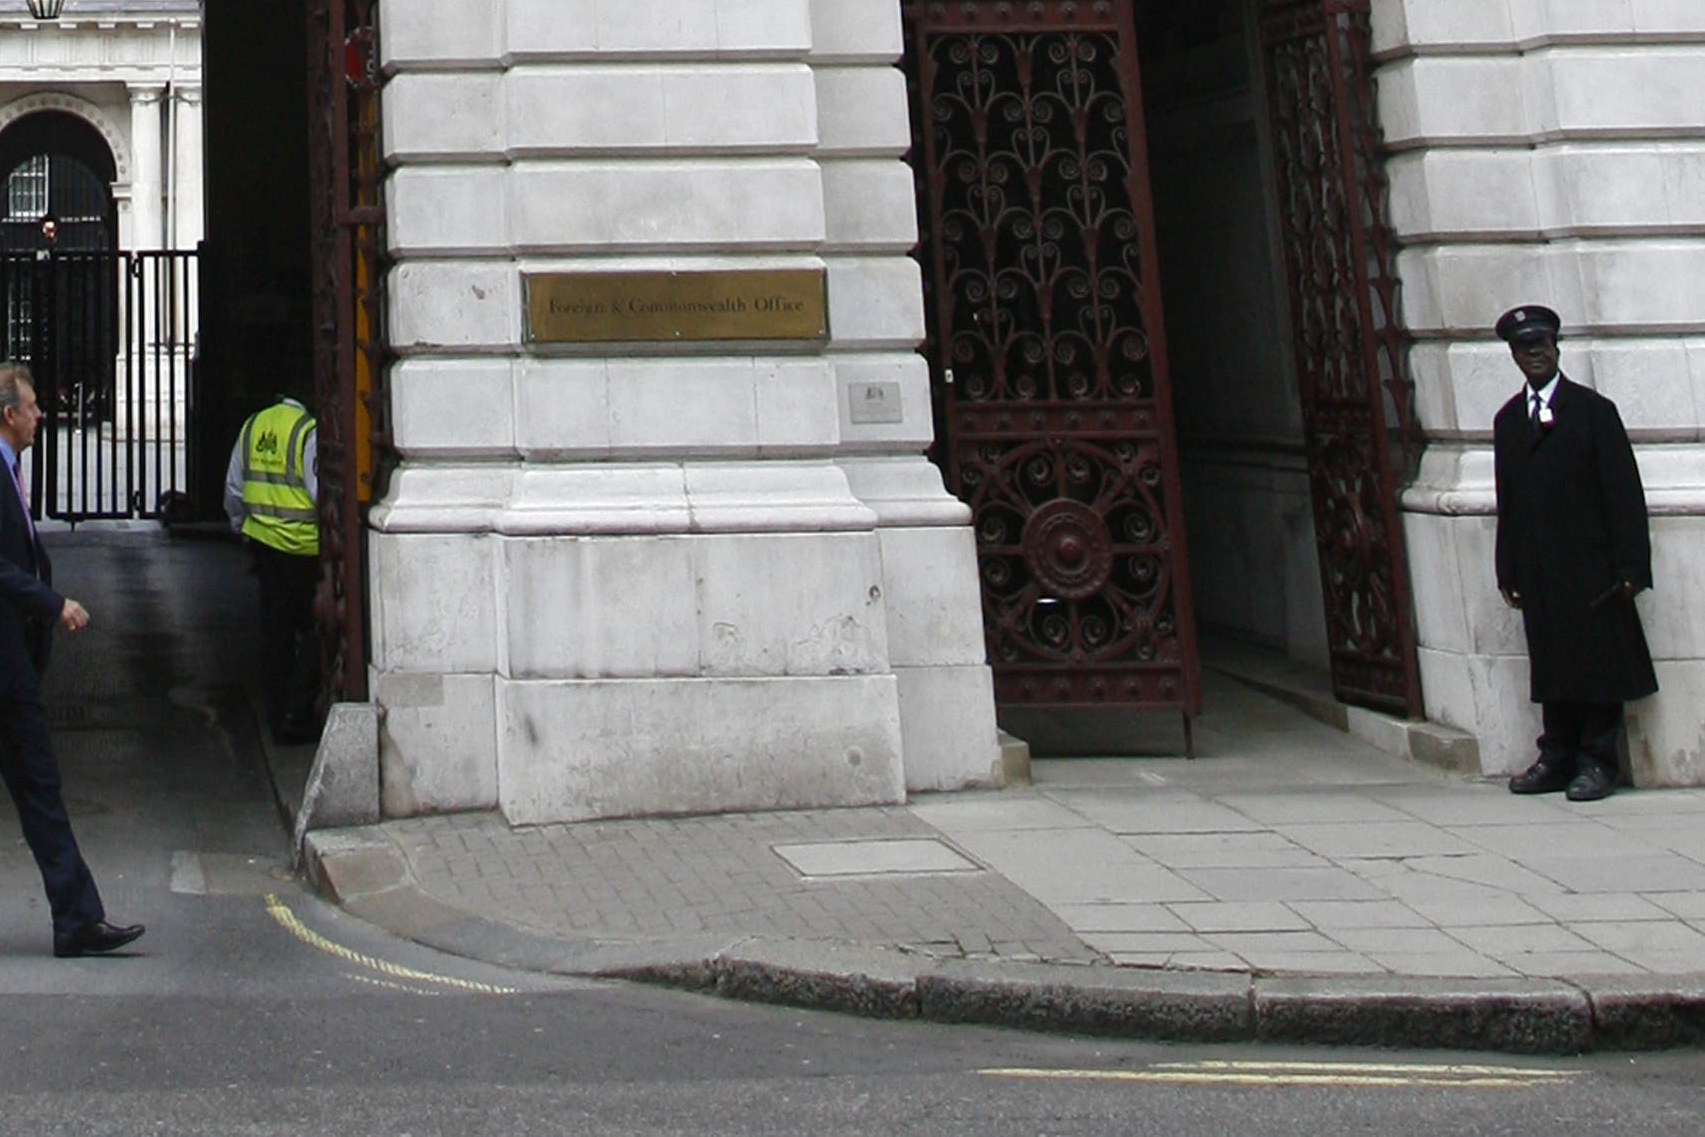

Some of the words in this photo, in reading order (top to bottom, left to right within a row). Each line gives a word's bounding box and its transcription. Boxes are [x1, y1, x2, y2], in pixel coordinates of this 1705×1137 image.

[550, 298, 604, 317] Foreign
[611, 299, 621, 313] &
[628, 295, 747, 313] Commonwealth
[754, 295, 804, 313] Office
